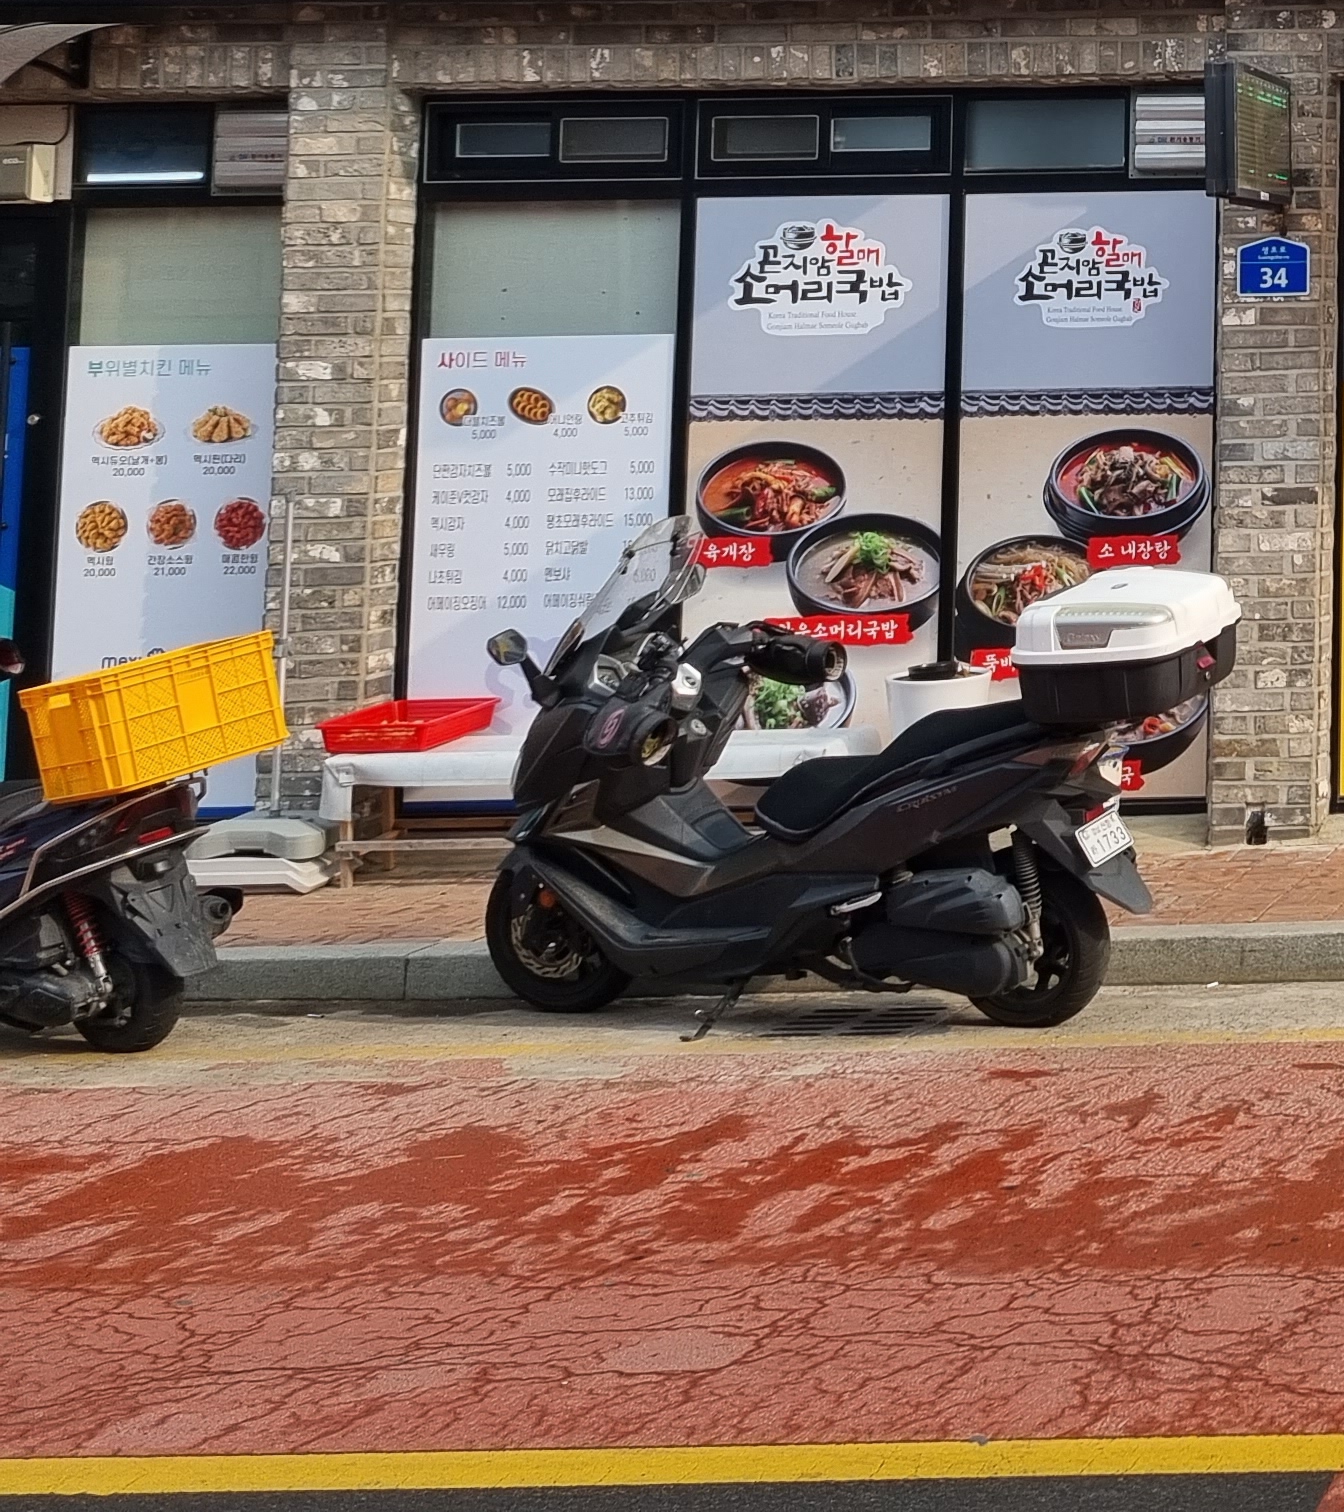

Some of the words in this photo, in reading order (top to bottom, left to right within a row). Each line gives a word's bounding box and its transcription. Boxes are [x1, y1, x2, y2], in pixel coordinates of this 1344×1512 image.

[819, 223, 880, 267] 할매
[1091, 230, 1142, 268] 할매
[757, 244, 836, 277] 곤지암
[1037, 248, 1105, 277] 곤지암
[733, 262, 904, 306] 소머리국밥
[1018, 264, 1162, 301] 소머리국밥
[1259, 267, 1289, 289] 34
[87, 359, 172, 378] 부위별치킨
[178, 358, 212, 376] 메뉴
[437, 351, 488, 369] 사이드
[494, 350, 528, 368] 메뉴
[620, 413, 654, 424] 고추튀김
[471, 428, 497, 440] 5,000
[552, 427, 578, 438] 4,000
[623, 426, 649, 437] 5,000
[112, 467, 146, 478] 20,000
[202, 466, 236, 476] 20,000
[506, 462, 532, 477] 5,000
[629, 460, 656, 475] 5,000
[504, 489, 532, 504] 4,000
[624, 486, 654, 501] 13,000
[504, 515, 531, 529] 4,000
[623, 512, 653, 527] 15,000
[503, 541, 530, 556] 5,000
[703, 541, 756, 563] 육개장
[1096, 540, 1115, 559] 소
[1120, 538, 1172, 561] 내장탕
[83, 567, 116, 578] 20,000
[153, 566, 187, 577] 21,000
[222, 565, 257, 576] 22,000
[502, 568, 528, 583] 4,000
[496, 594, 528, 609] 12,000
